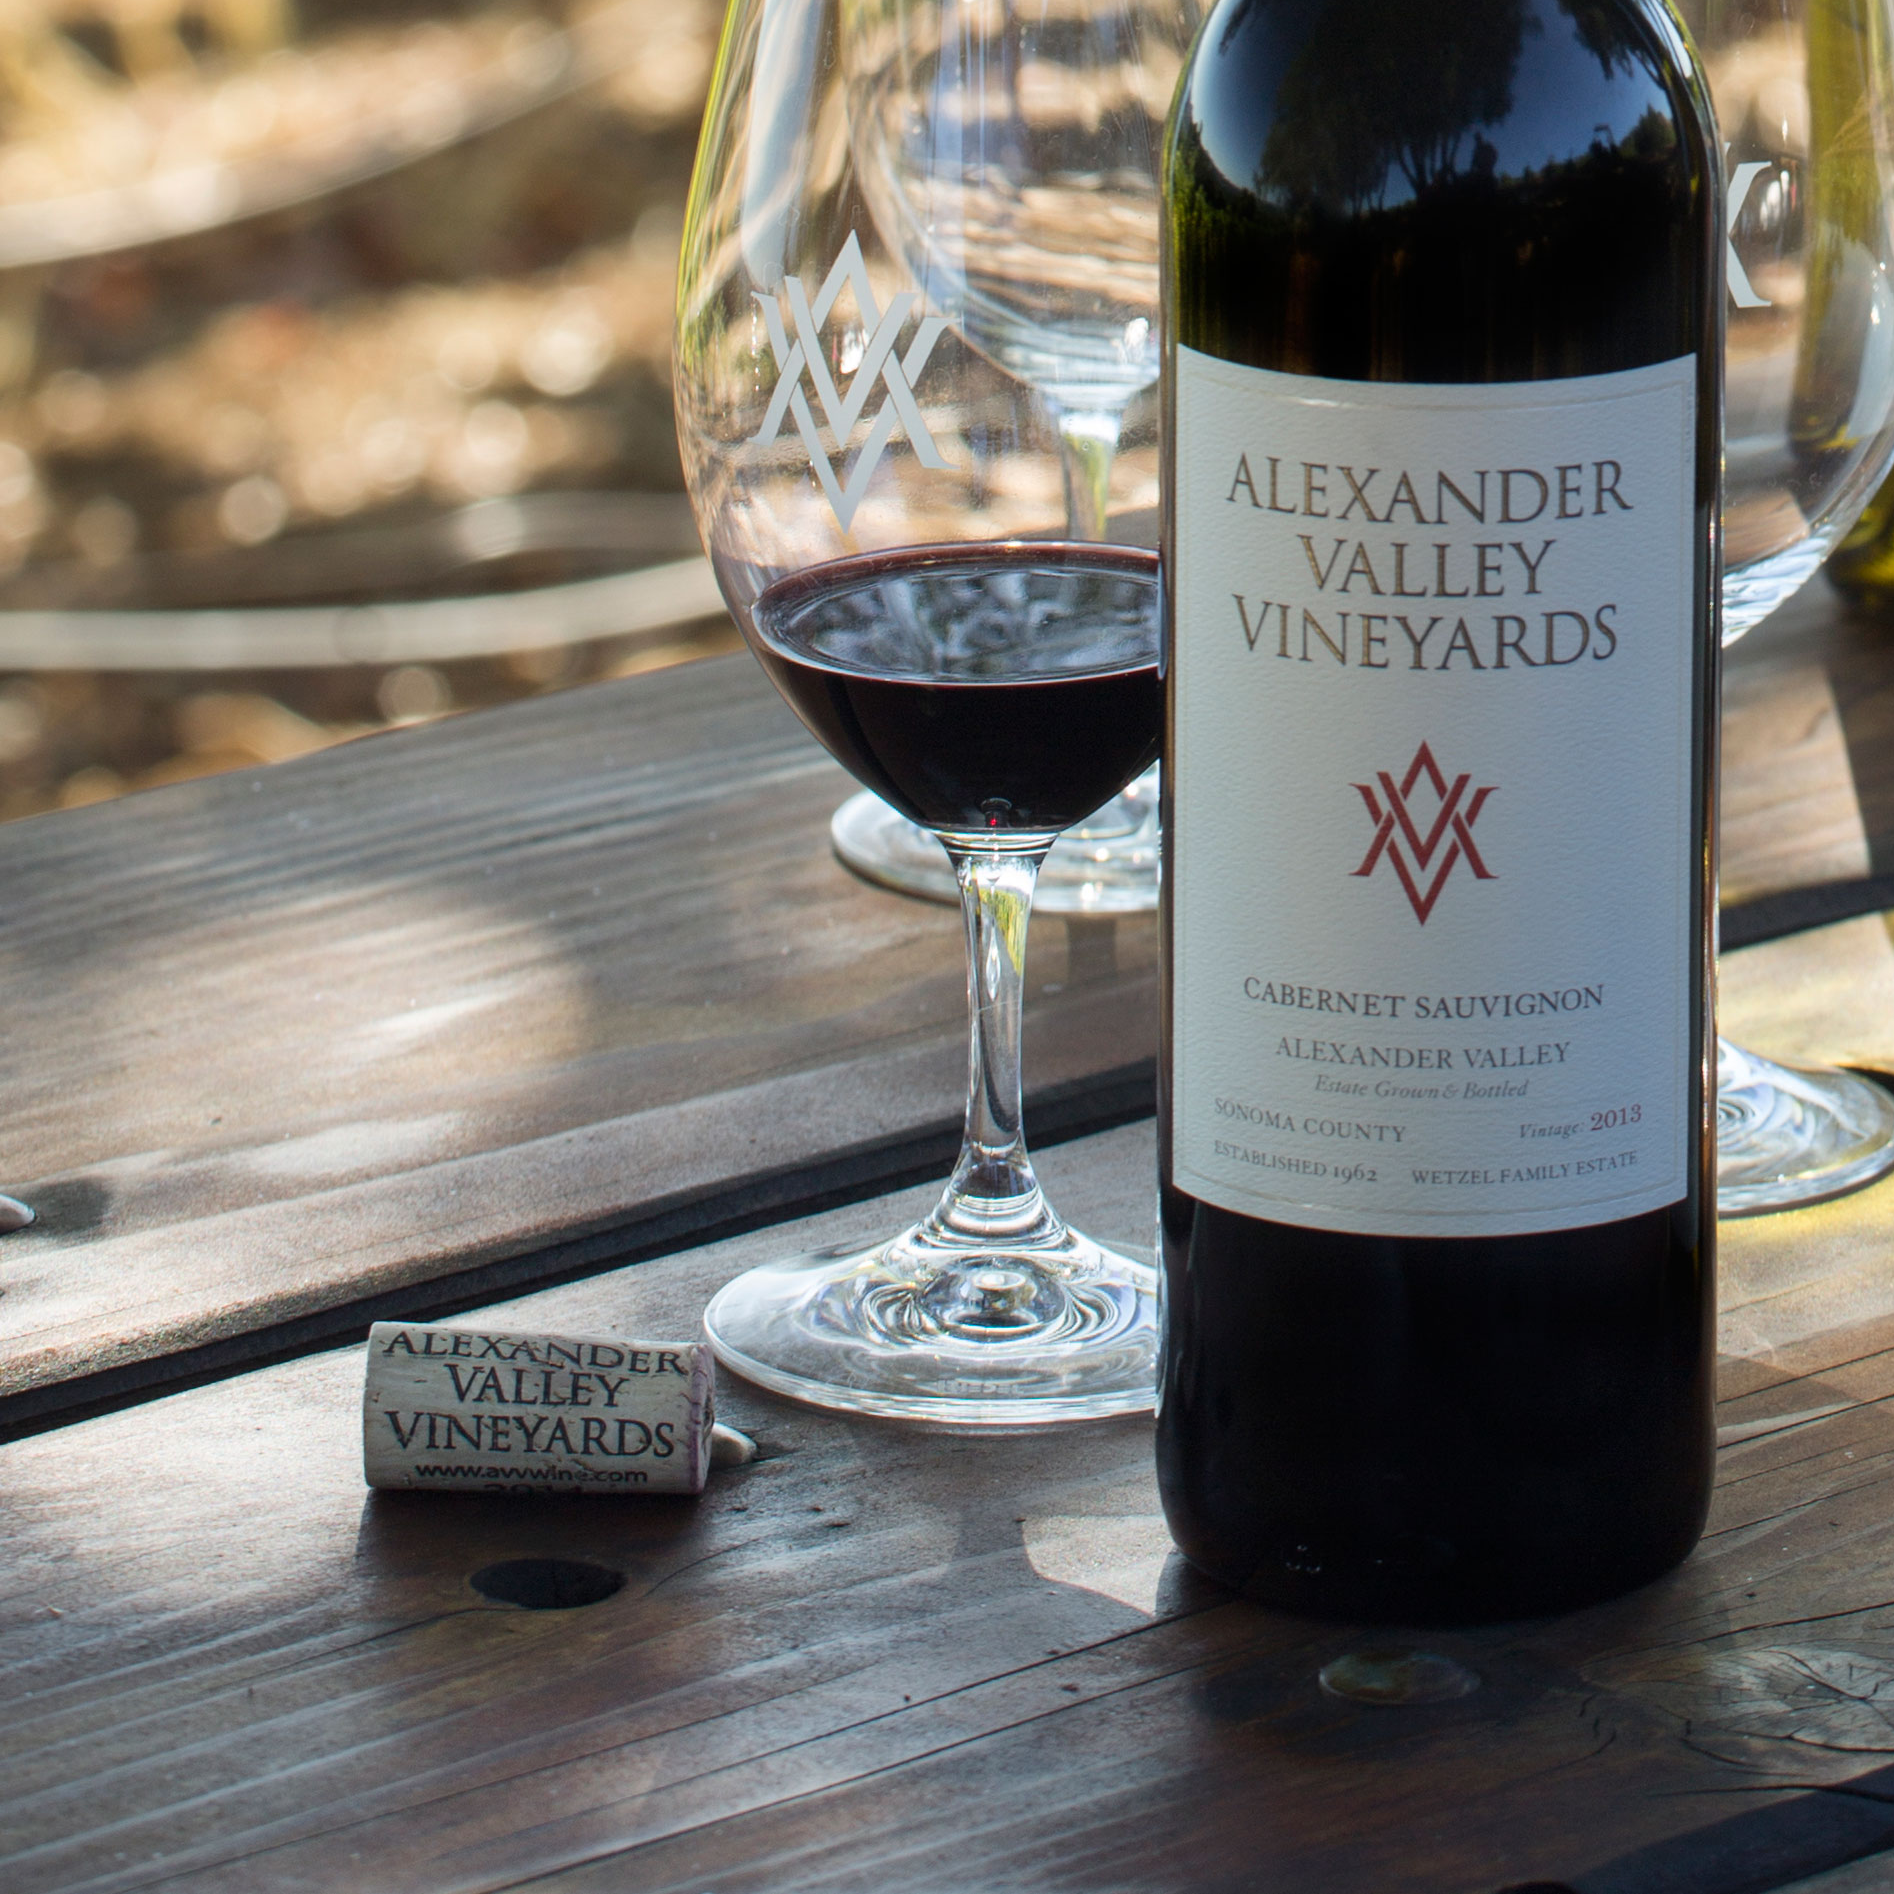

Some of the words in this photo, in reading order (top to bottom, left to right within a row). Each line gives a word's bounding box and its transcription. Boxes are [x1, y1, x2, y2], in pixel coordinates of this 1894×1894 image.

[1226, 452, 1634, 524] ALEXANDER
[1298, 534, 1556, 597] VALLEY
[1232, 593, 1617, 670] VINEYARDS
[1243, 976, 1406, 1018] CABERNET
[1414, 983, 1604, 1019] SAUVIGNON
[1275, 1036, 1453, 1070] ALEXANDER
[1463, 1041, 1570, 1069] VALLEY
[1314, 1074, 1369, 1097] Estate
[1374, 1078, 1440, 1100] Grown
[1442, 1081, 1459, 1099] &
[1463, 1079, 1529, 1099] Bottled
[1213, 1097, 1296, 1132] SONOMA
[1303, 1117, 1406, 1142] COUNTY
[1518, 1120, 1584, 1140] Vintage:
[1590, 1104, 1642, 1132] 2013
[1213, 1140, 1327, 1177] ESTABLISHED
[1333, 1166, 1378, 1184] 1962
[1411, 1167, 1495, 1185] WETZEL
[1499, 1162, 1571, 1184] FAMILY
[1575, 1150, 1638, 1176] ESTATE
[383, 1331, 689, 1376] ALEXANDER
[444, 1363, 630, 1408] VALLEY
[384, 1411, 675, 1458] VINEYARDS
[415, 1464, 648, 1484] www.avvwine.com
